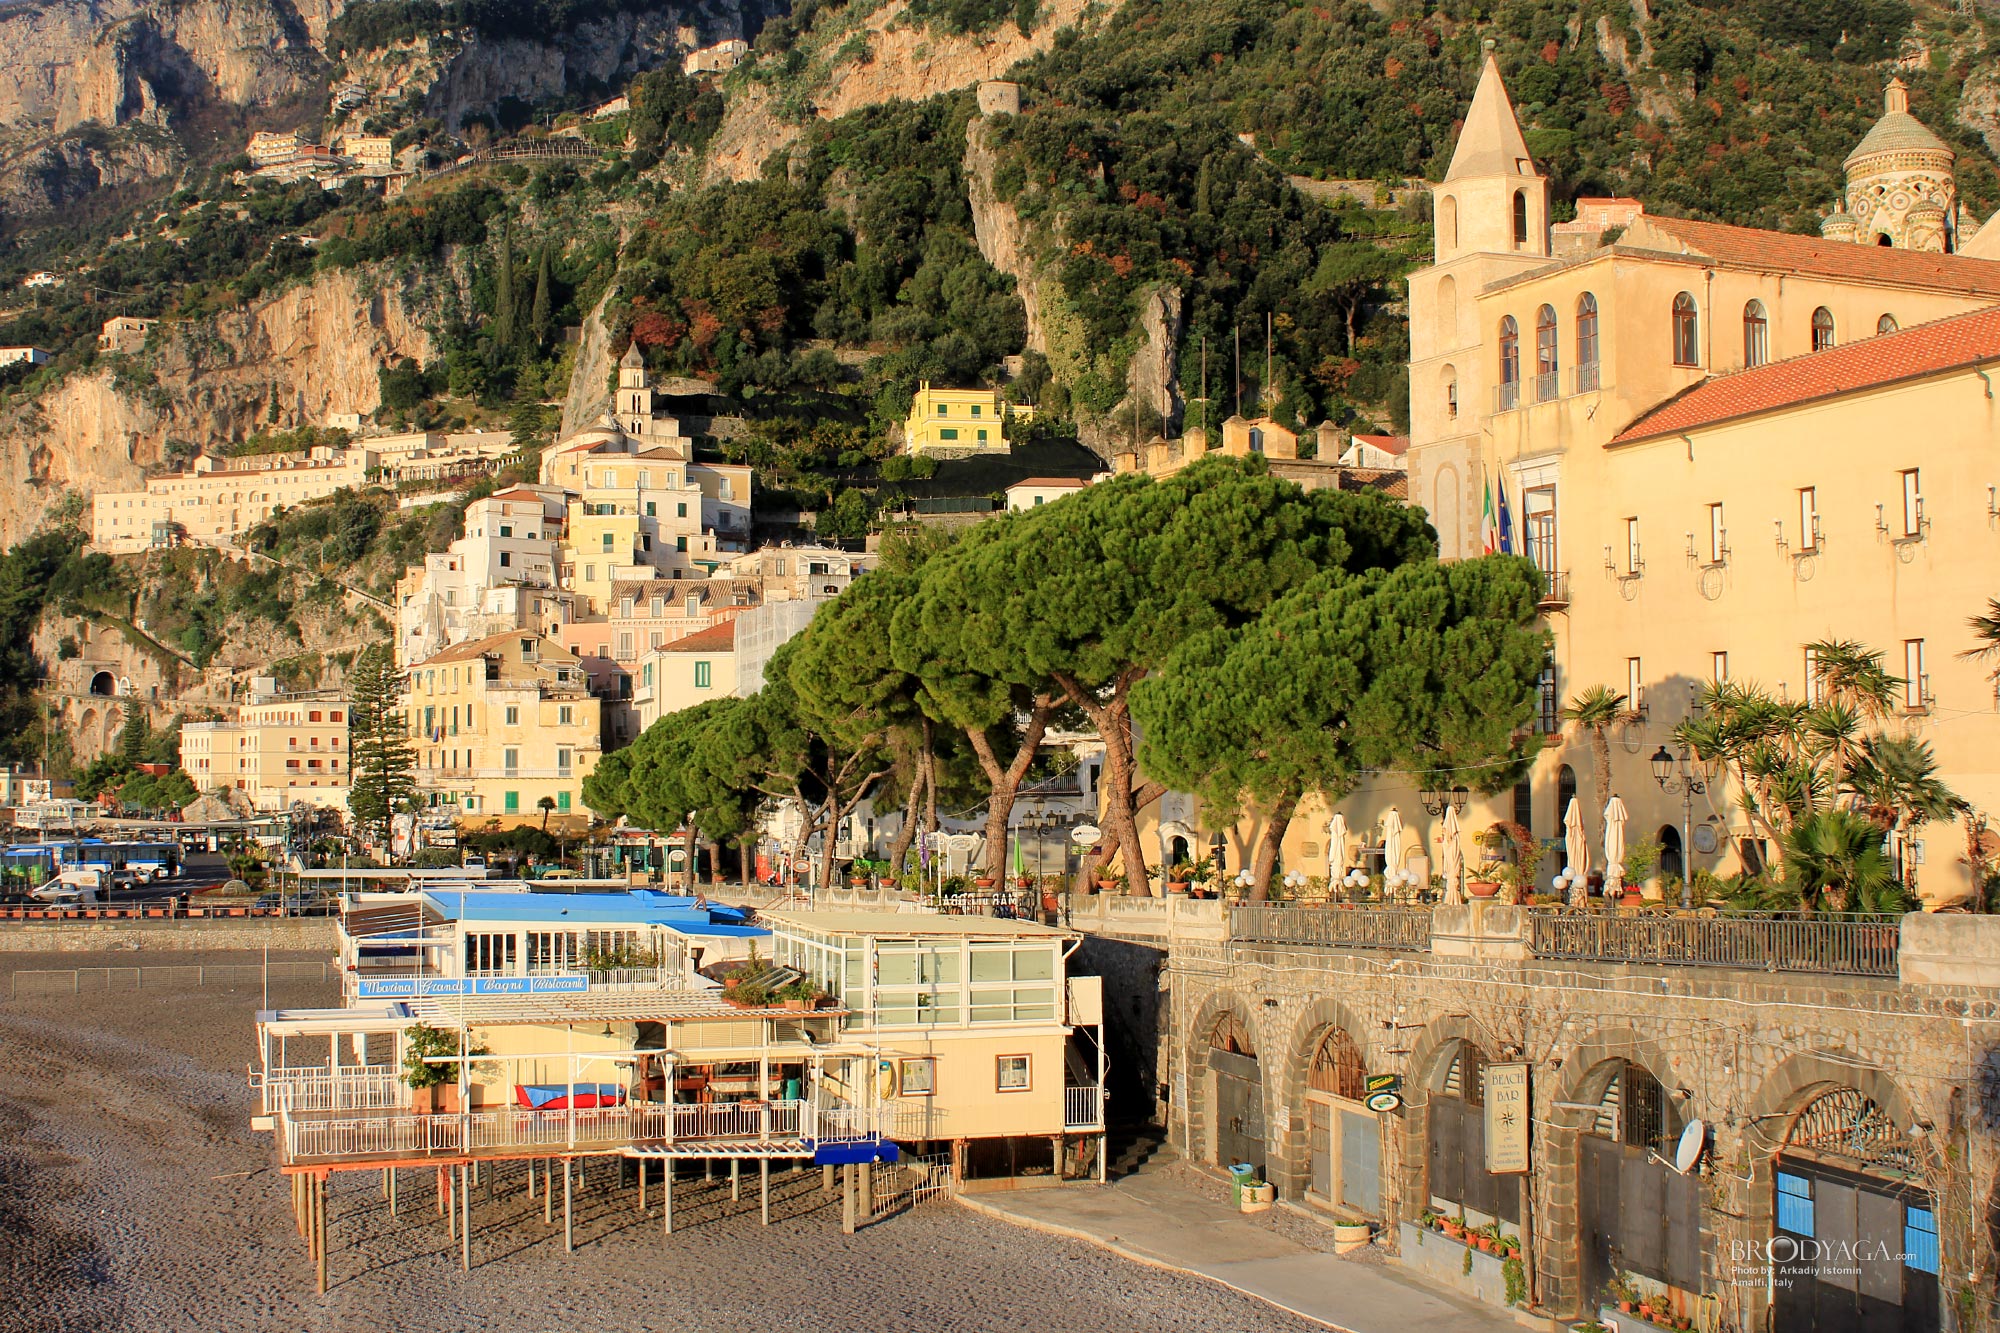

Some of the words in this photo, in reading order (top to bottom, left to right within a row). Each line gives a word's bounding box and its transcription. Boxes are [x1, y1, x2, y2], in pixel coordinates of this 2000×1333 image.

[364, 980, 412, 993] Marina
[421, 979, 467, 993] Grande
[484, 979, 523, 993] Bagni
[534, 978, 584, 991] Ristorante
[1492, 1073, 1524, 1086] BEACH
[1497, 1090, 1520, 1102] BAR
